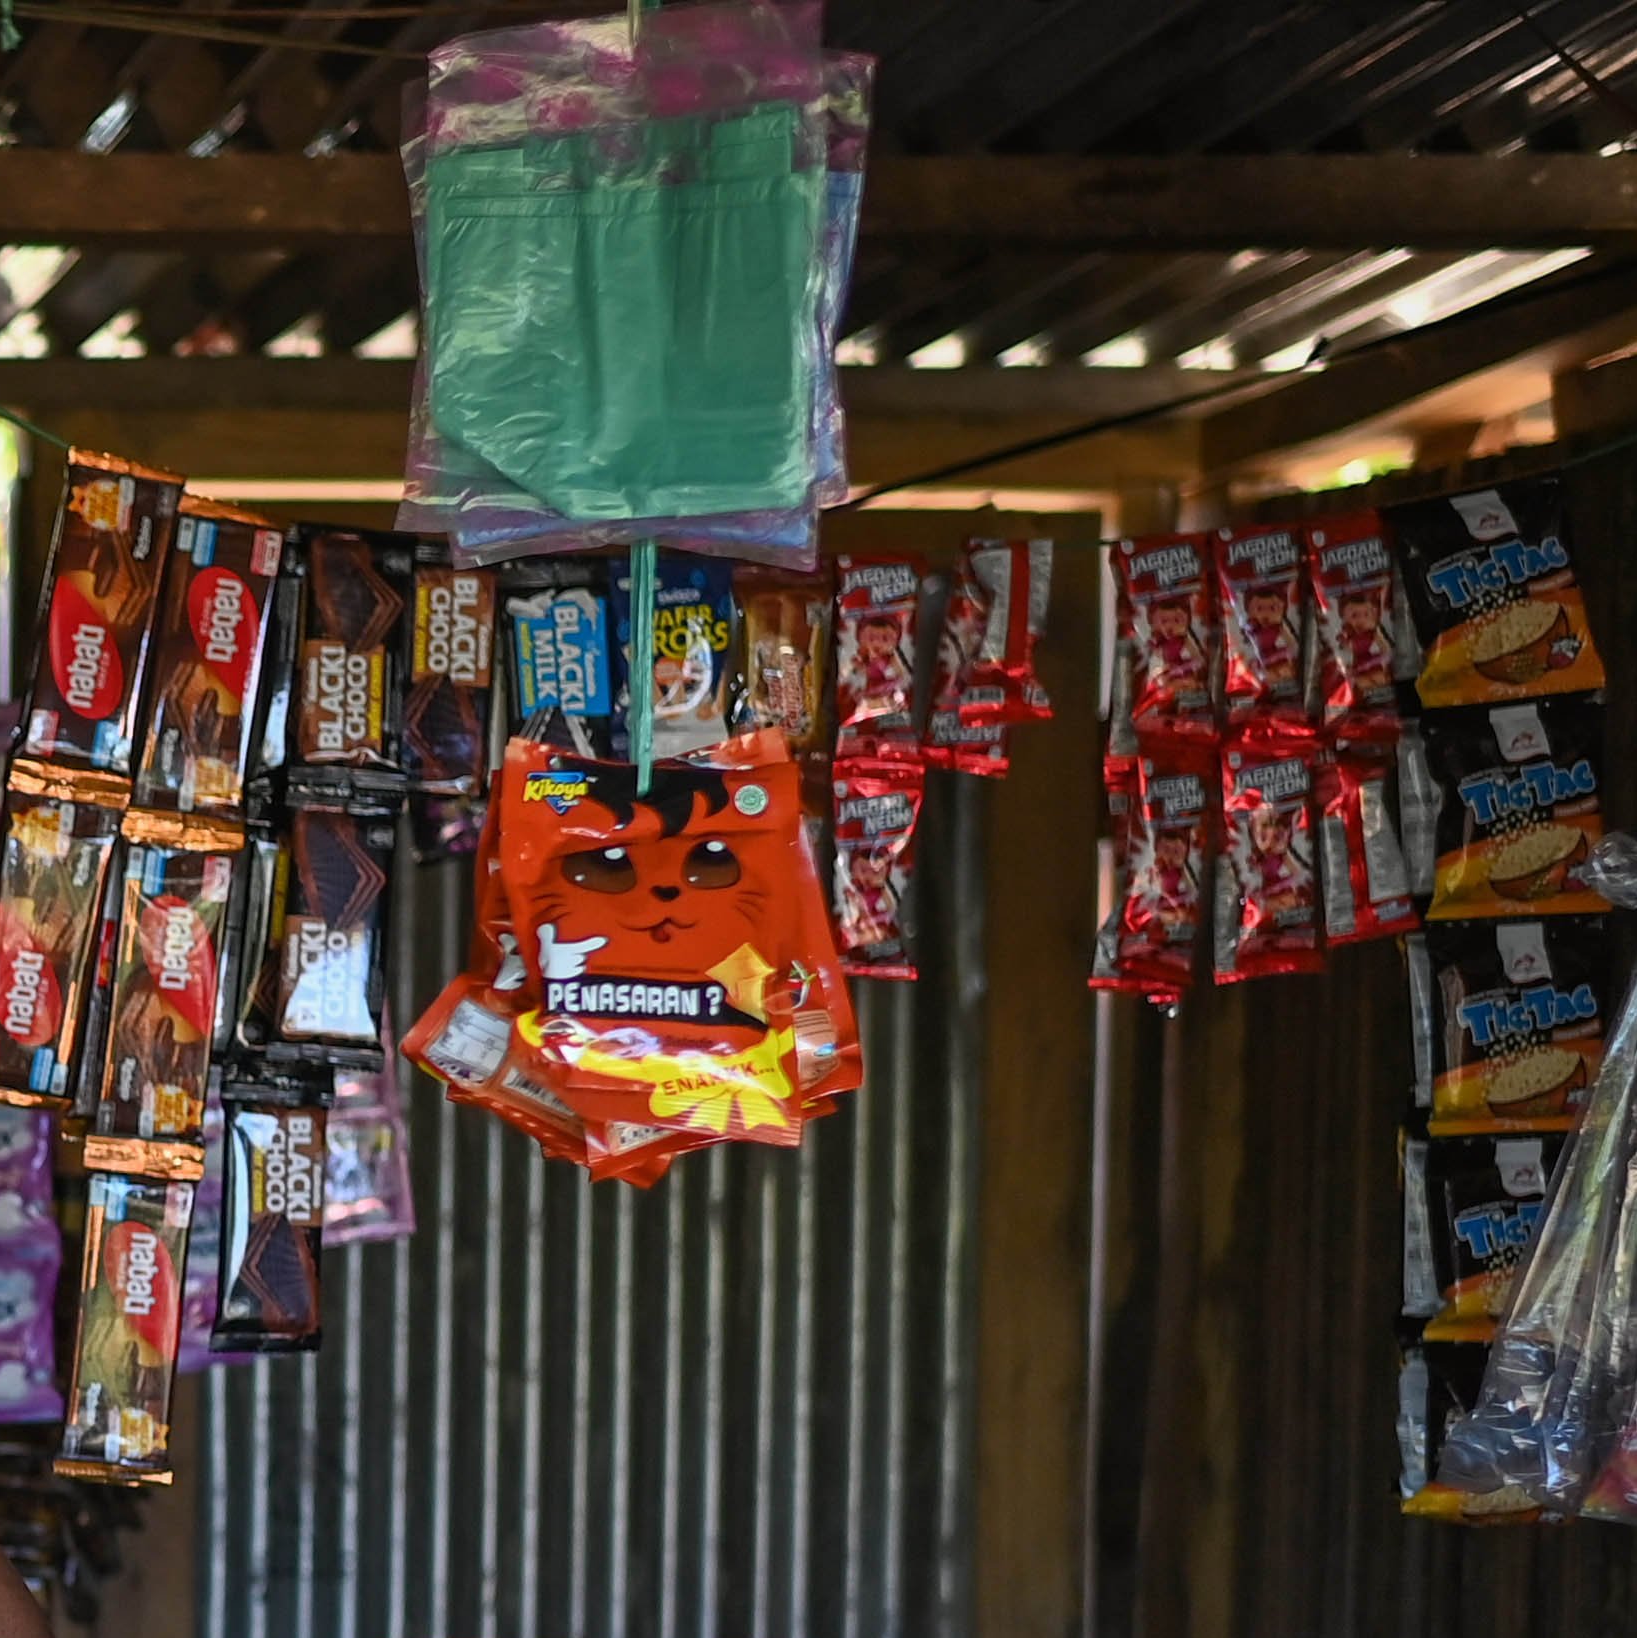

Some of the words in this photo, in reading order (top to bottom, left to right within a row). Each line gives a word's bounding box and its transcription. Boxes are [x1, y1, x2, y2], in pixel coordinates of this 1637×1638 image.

[1157, 558, 1201, 587] NEON
[1254, 546, 1298, 574] NEON
[1347, 551, 1390, 580] NEON
[205, 578, 244, 664] nabati
[428, 586, 451, 673] CHOCO
[450, 576, 479, 681] BLACKI
[552, 603, 586, 712] BLACKI
[66, 623, 106, 709] nabati
[317, 645, 346, 749] BLACKI
[345, 653, 368, 741] CHOCO
[531, 628, 557, 701] MILK
[523, 776, 590, 802] Kikoya
[1261, 773, 1309, 801] NEON
[159, 906, 195, 991] nabati
[4, 950, 45, 1036] nabati
[547, 982, 701, 1017] PENASARAN
[705, 985, 724, 1017] ?
[265, 1127, 286, 1213] CHOCO
[285, 1114, 312, 1222] BLACKI
[124, 1231, 160, 1315] nabati
